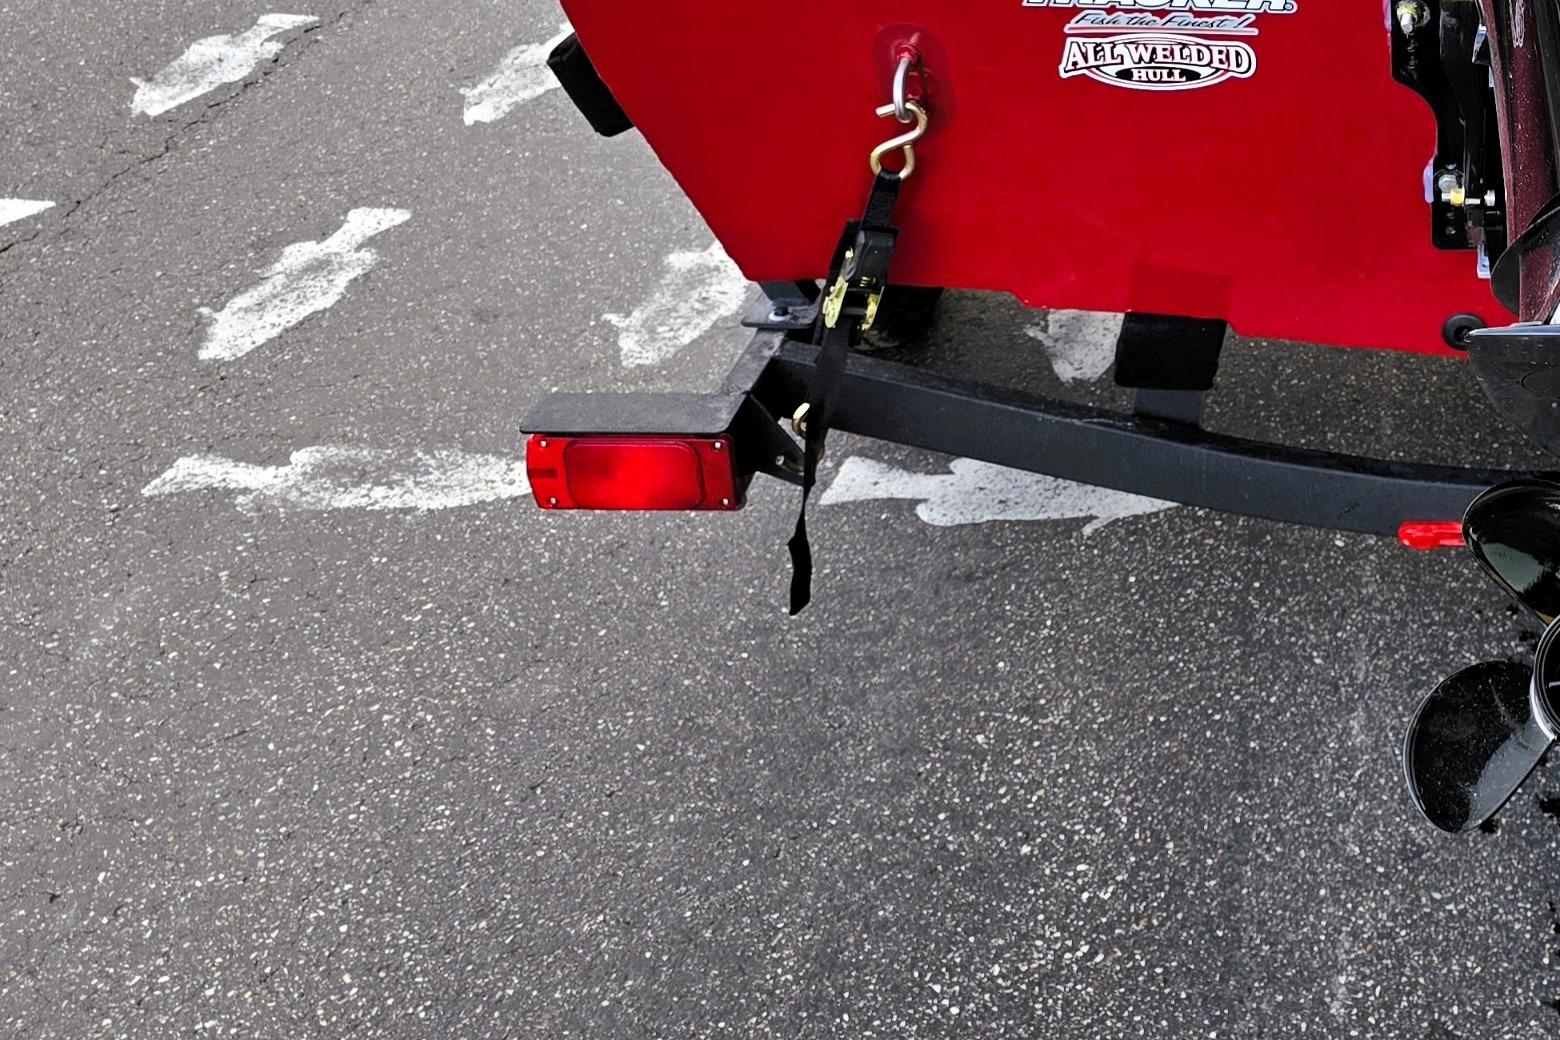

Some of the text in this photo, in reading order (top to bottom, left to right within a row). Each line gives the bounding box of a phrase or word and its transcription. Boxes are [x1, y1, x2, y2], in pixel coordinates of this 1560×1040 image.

[1073, 11, 1121, 27] Fish
[1128, 12, 1158, 27] the
[1064, 40, 1252, 74] ALL WELDED
[1131, 68, 1187, 82] HULL
